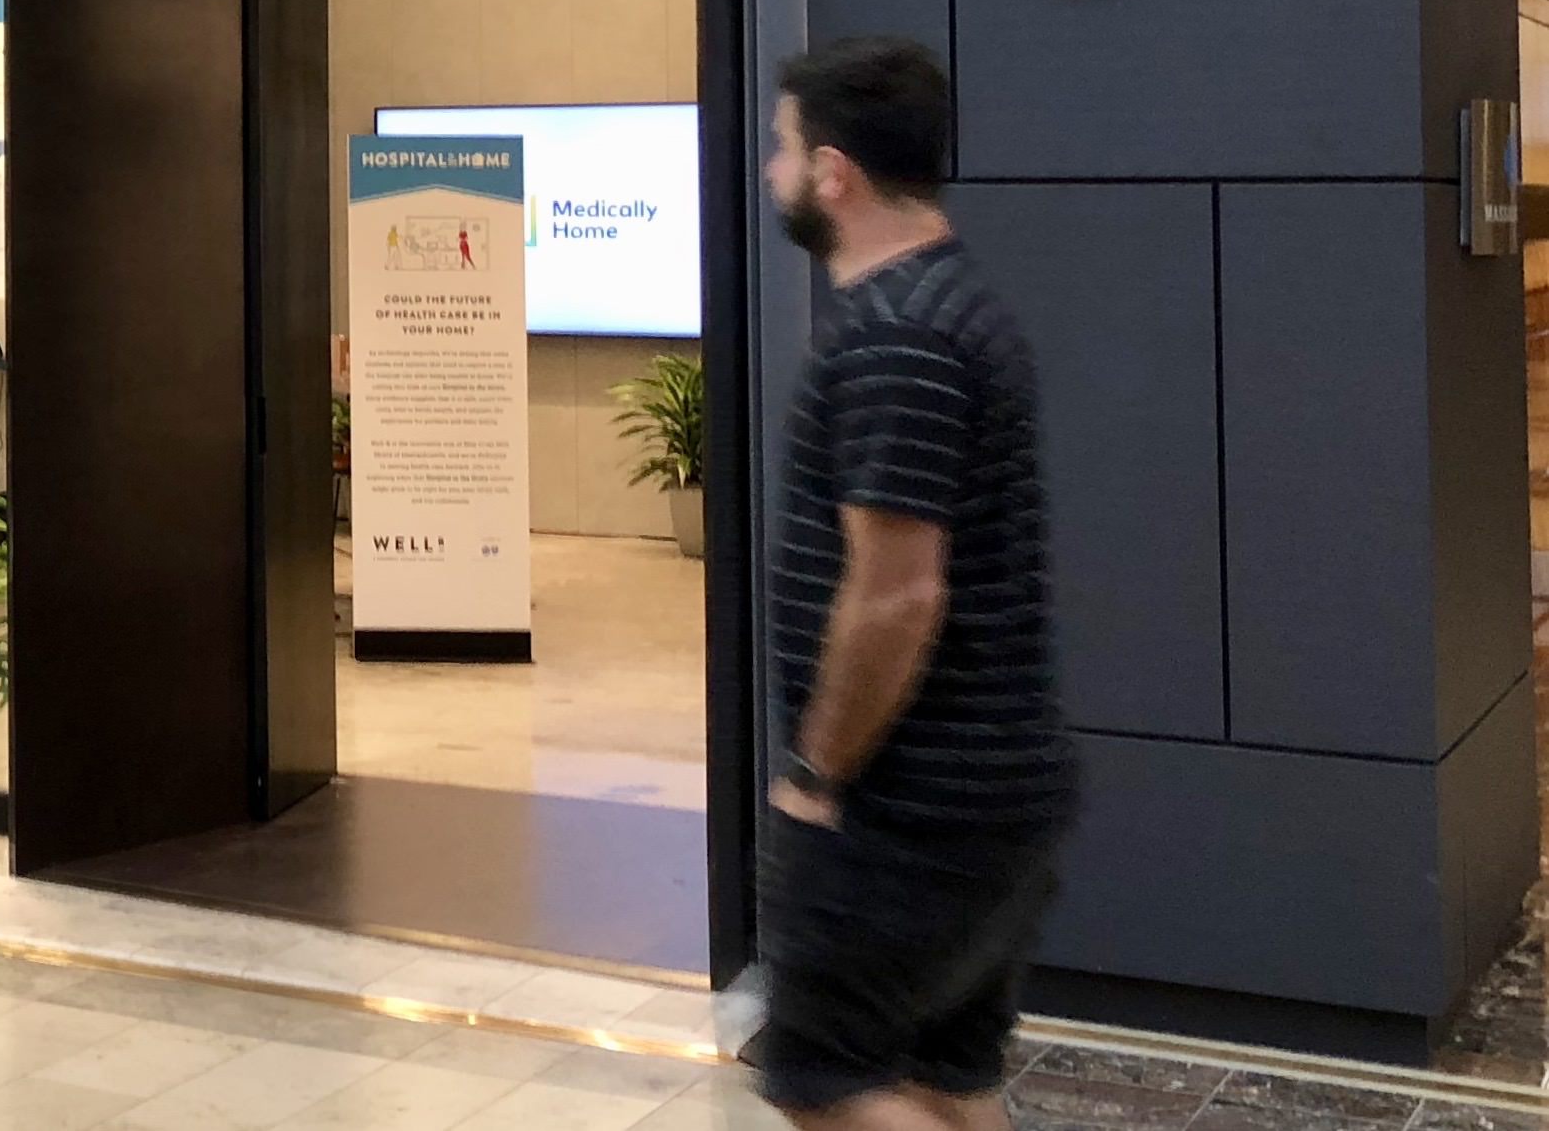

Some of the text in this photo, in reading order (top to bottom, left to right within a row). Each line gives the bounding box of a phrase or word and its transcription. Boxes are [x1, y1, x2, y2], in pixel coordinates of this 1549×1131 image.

[552, 200, 658, 222] Medically
[552, 221, 618, 239] Home
[384, 294, 492, 305] COULD THE FUTURE
[375, 309, 501, 320] OF HEALTH CARE BE IN
[402, 325, 475, 336] YOUR HOME?
[372, 535, 433, 552] WELL
